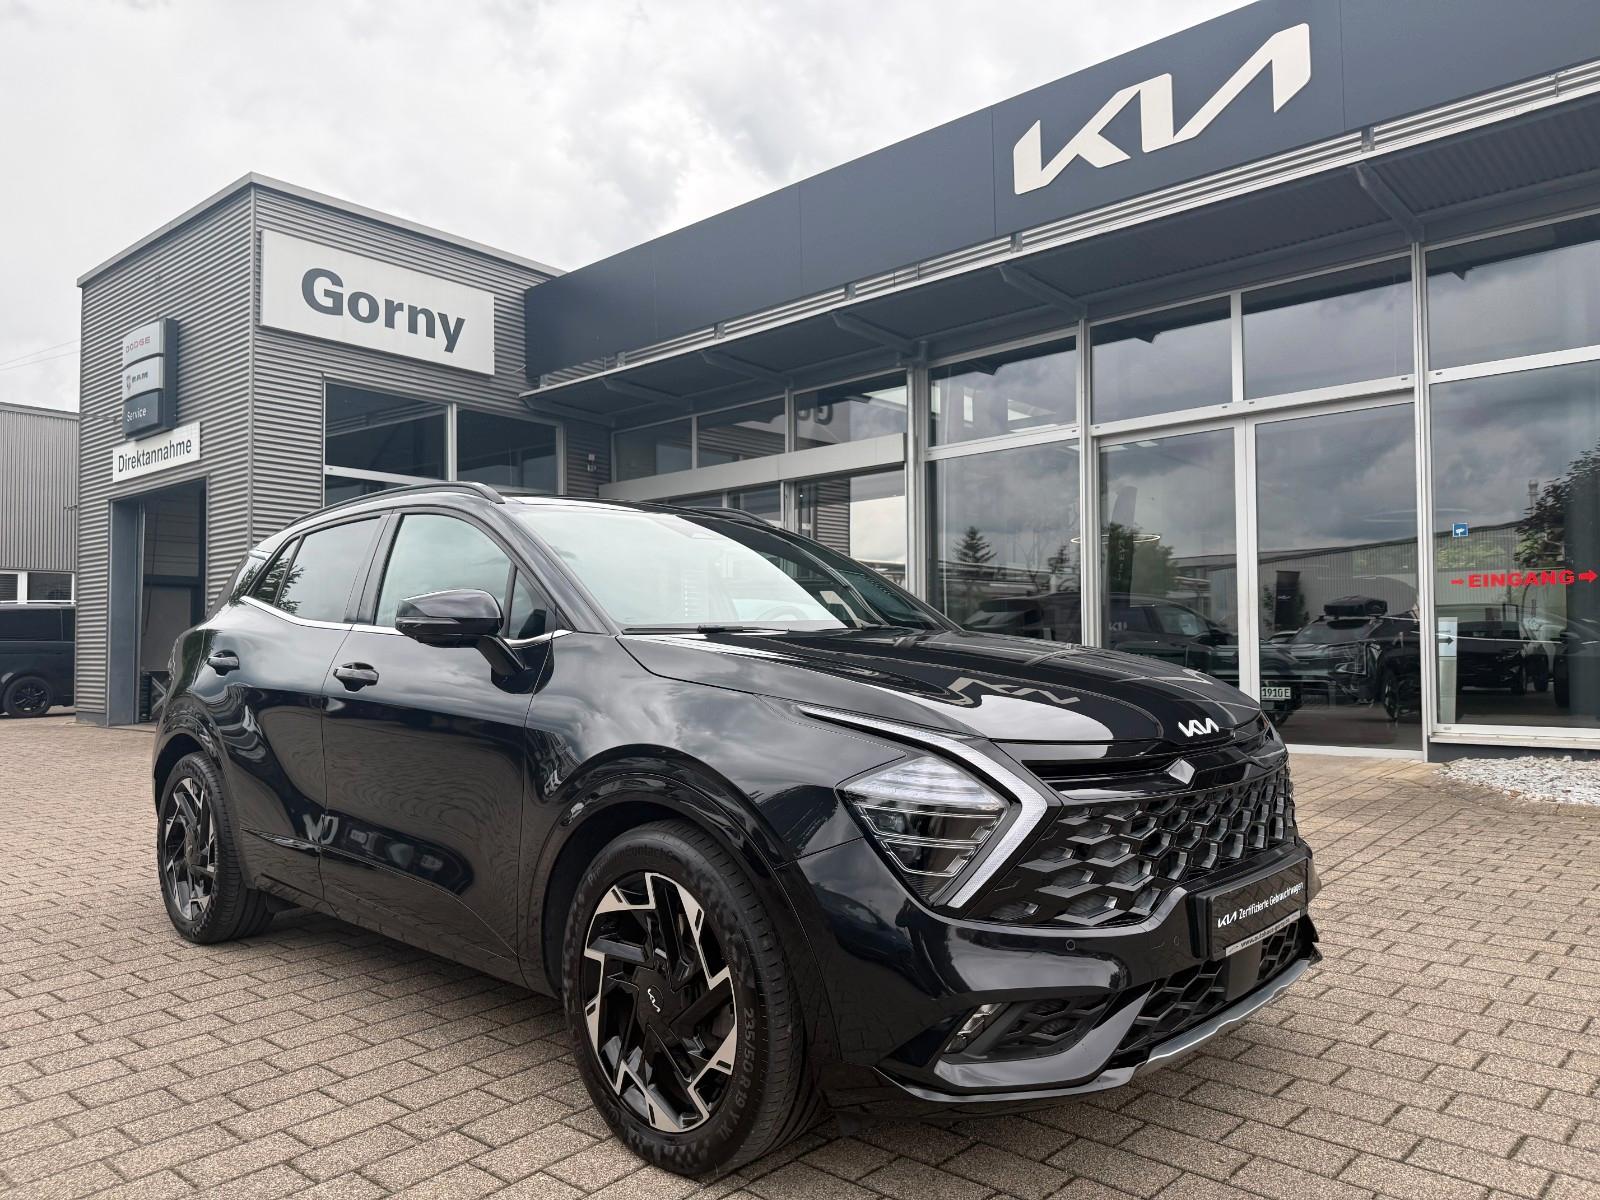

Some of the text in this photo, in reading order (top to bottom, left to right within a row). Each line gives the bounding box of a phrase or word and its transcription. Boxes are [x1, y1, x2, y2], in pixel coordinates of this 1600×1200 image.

[1013, 23, 1311, 194] KIA
[302, 267, 465, 353] Gorny
[125, 336, 151, 353] DODGE
[126, 407, 147, 422] Service
[118, 439, 192, 473] Direktannahme
[1468, 570, 1575, 588] EINGANG
[1178, 717, 1220, 737] KIA
[1217, 881, 1304, 928] KIA Zertifizierte Gebrauchtwagen
[743, 1007, 756, 1073] 235/50
